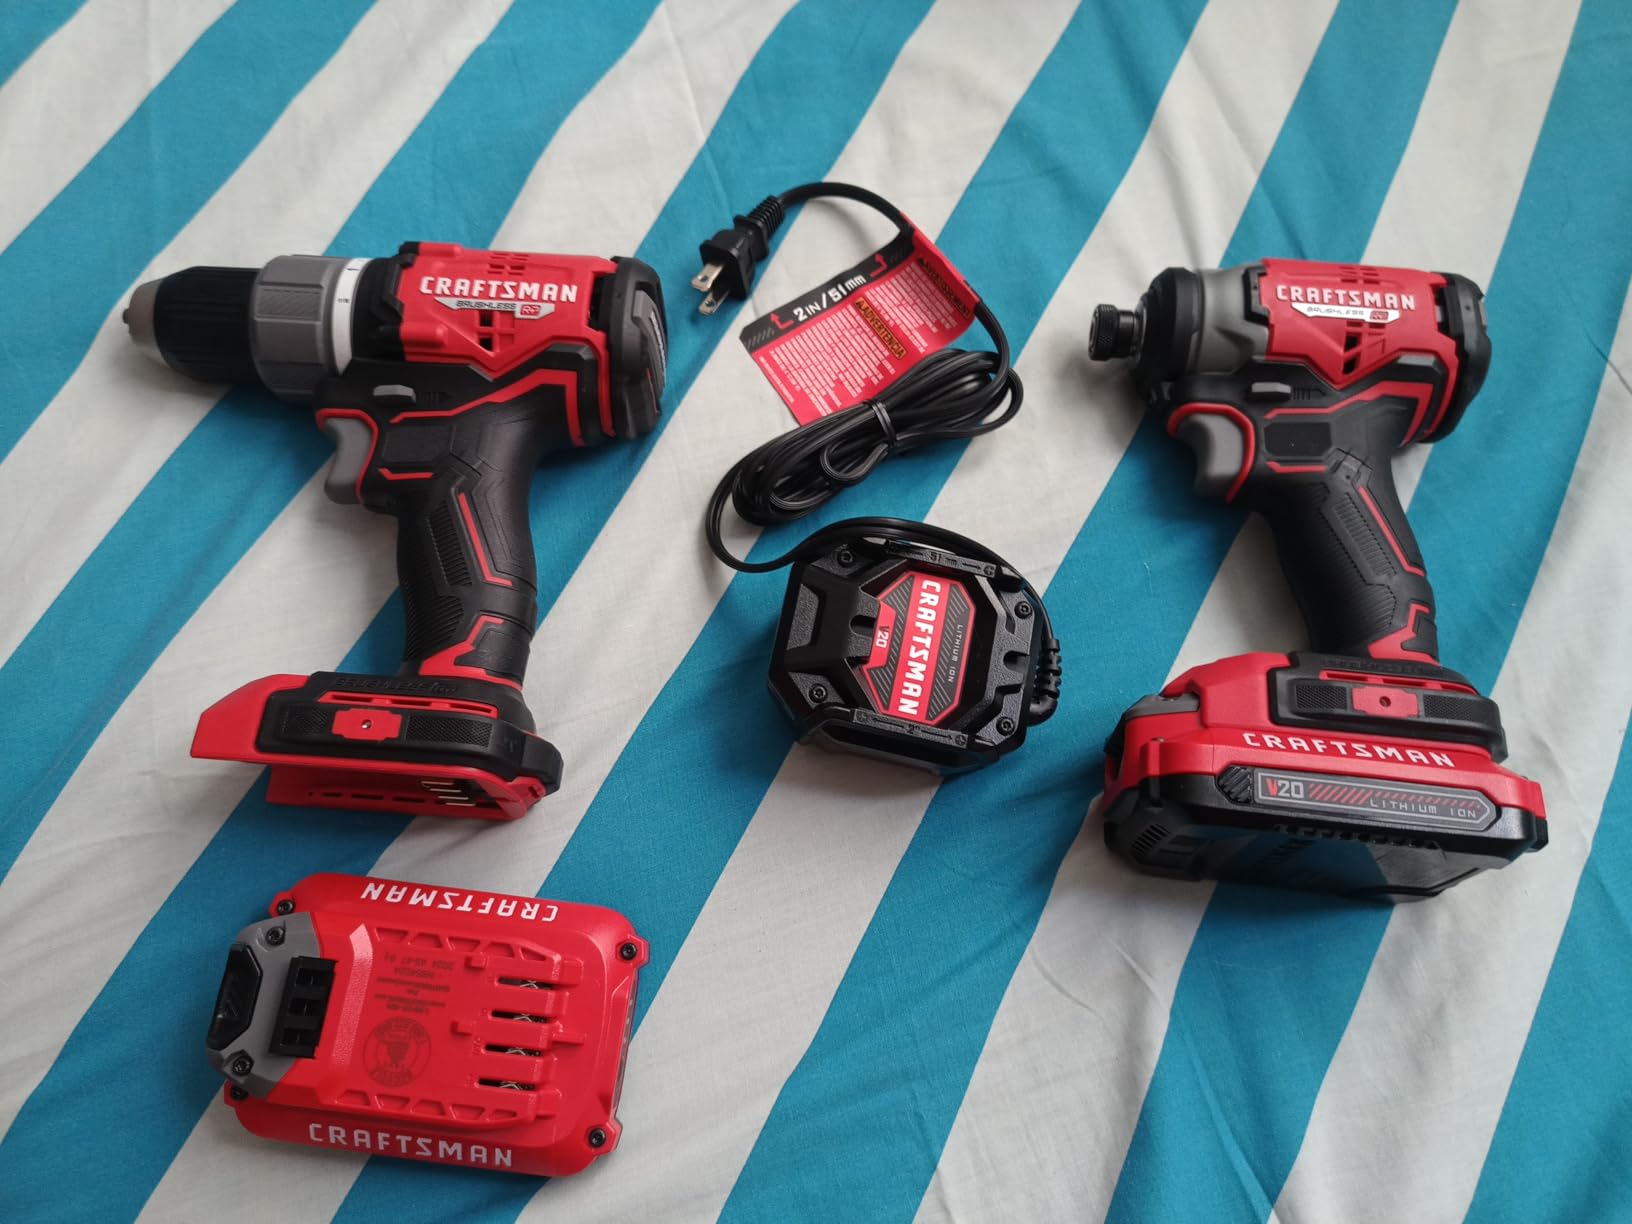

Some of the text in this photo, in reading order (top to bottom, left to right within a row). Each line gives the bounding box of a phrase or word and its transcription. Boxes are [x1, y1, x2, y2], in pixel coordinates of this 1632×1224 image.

[419, 276, 578, 303] CRAFTSMAN
[1276, 284, 1416, 311] CRAFTSMAN
[456, 300, 517, 310] BRUSHLESS
[875, 625, 890, 648] V20
[898, 579, 941, 715] CRAFTSMAN
[948, 666, 957, 682] ION
[1243, 732, 1455, 768] CRAFTSMAN
[1265, 777, 1304, 799] V20
[1369, 799, 1476, 819] LITHIUM ION
[360, 882, 559, 922] CRAFTSMAN
[309, 1123, 512, 1167] CRAFTSMAN
